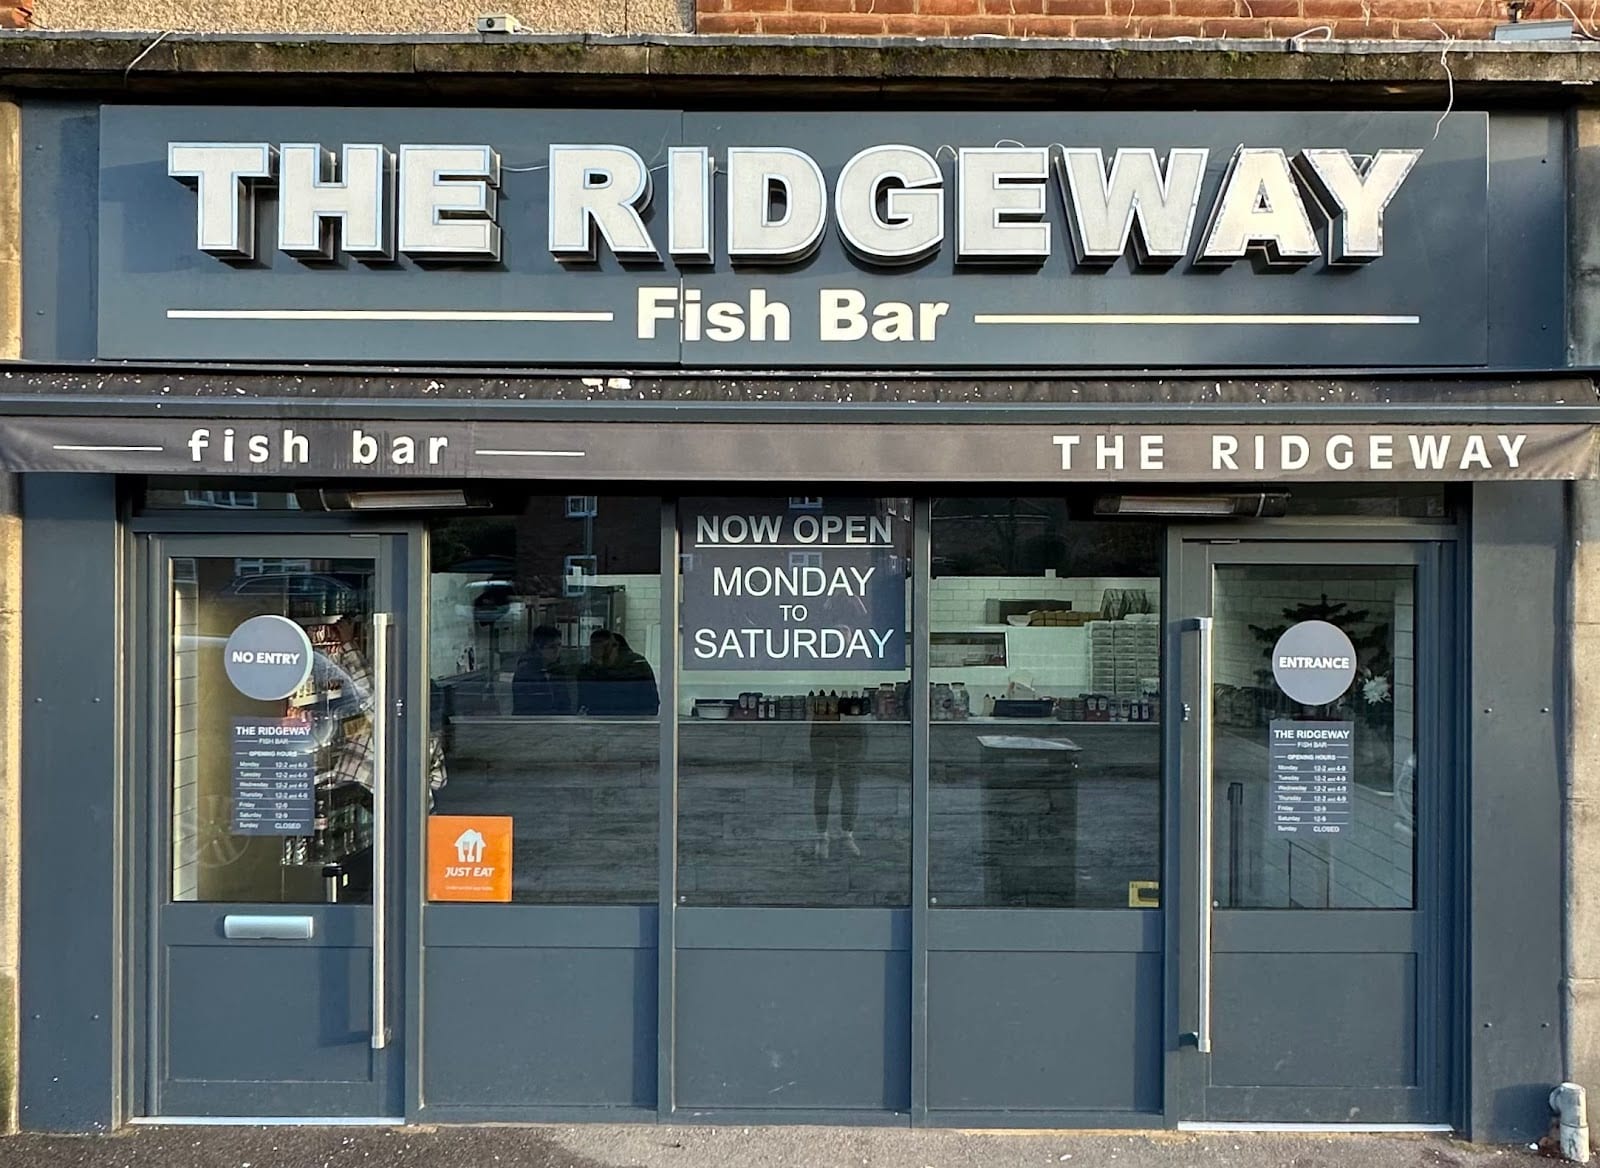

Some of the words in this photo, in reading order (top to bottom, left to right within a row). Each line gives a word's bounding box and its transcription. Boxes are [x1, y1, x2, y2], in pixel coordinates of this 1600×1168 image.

[167, 142, 500, 259] THE
[548, 143, 1423, 264] RIDGEWAY
[636, 286, 791, 342] Fish
[819, 288, 949, 342] Bar
[188, 428, 310, 465] fish
[352, 430, 449, 466] bar
[1052, 434, 1165, 471] THE
[1211, 433, 1528, 471] RIDGEWAY
[696, 515, 783, 544] NOW
[793, 515, 893, 544] OPEN
[712, 566, 876, 597] MONDAY
[778, 604, 808, 622] TO
[232, 651, 254, 664] NO
[256, 652, 300, 665] ENTRY
[694, 628, 895, 660] SATURDAY
[1278, 656, 1350, 670] ENTRANCE
[235, 726, 256, 736] THE
[258, 726, 311, 736] RIDGEWAY
[1273, 729, 1295, 739] THE
[1296, 729, 1350, 739] RIDGEWAY
[444, 867, 472, 878] JUST
[473, 867, 495, 877] EAT
